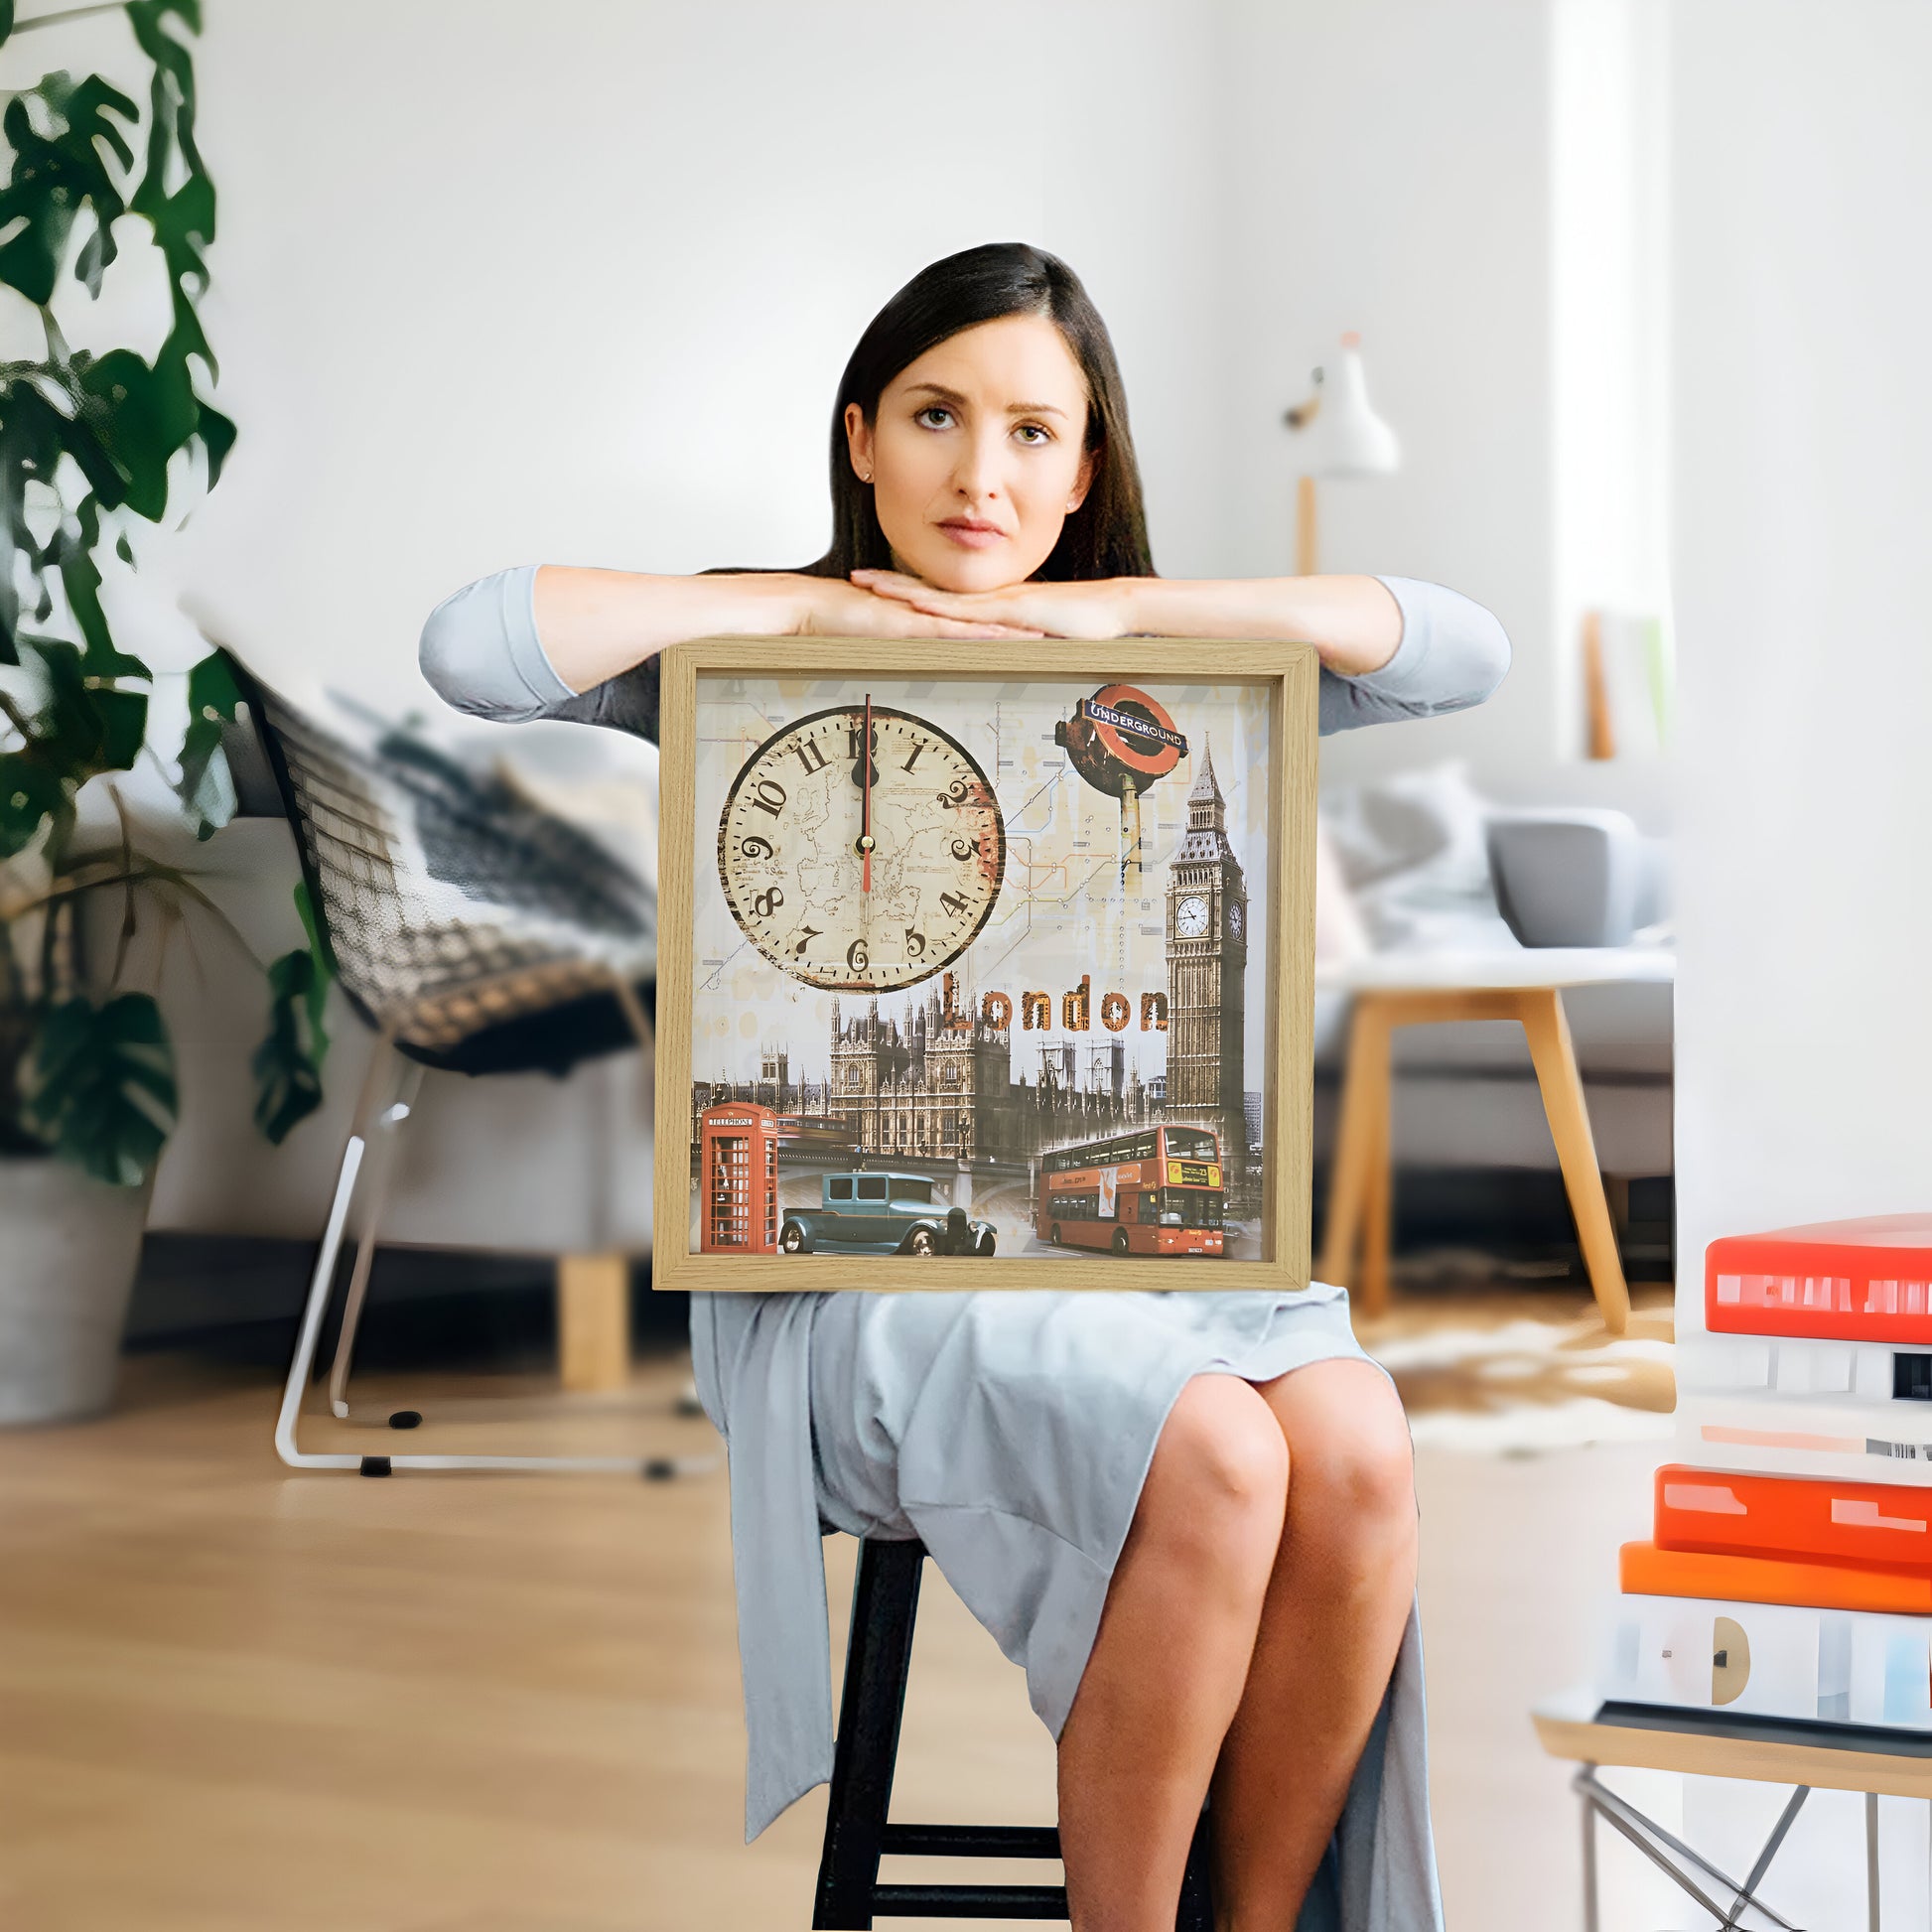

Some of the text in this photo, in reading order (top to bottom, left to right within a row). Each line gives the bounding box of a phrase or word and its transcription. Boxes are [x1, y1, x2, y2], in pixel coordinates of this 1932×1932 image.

[1090, 702, 1182, 746] UNDERGROUND
[792, 739, 833, 776] 11
[844, 729, 879, 759] 1
[900, 742, 926, 775] 1
[751, 779, 787, 820] 10
[936, 780, 969, 810] 2
[741, 835, 774, 861] 9
[950, 838, 985, 862] 3
[754, 887, 785, 917] 8
[939, 890, 970, 918] 4
[796, 924, 824, 955] 7
[846, 938, 870, 973] 6
[904, 924, 927, 957] 5
[942, 972, 1170, 1033] London
